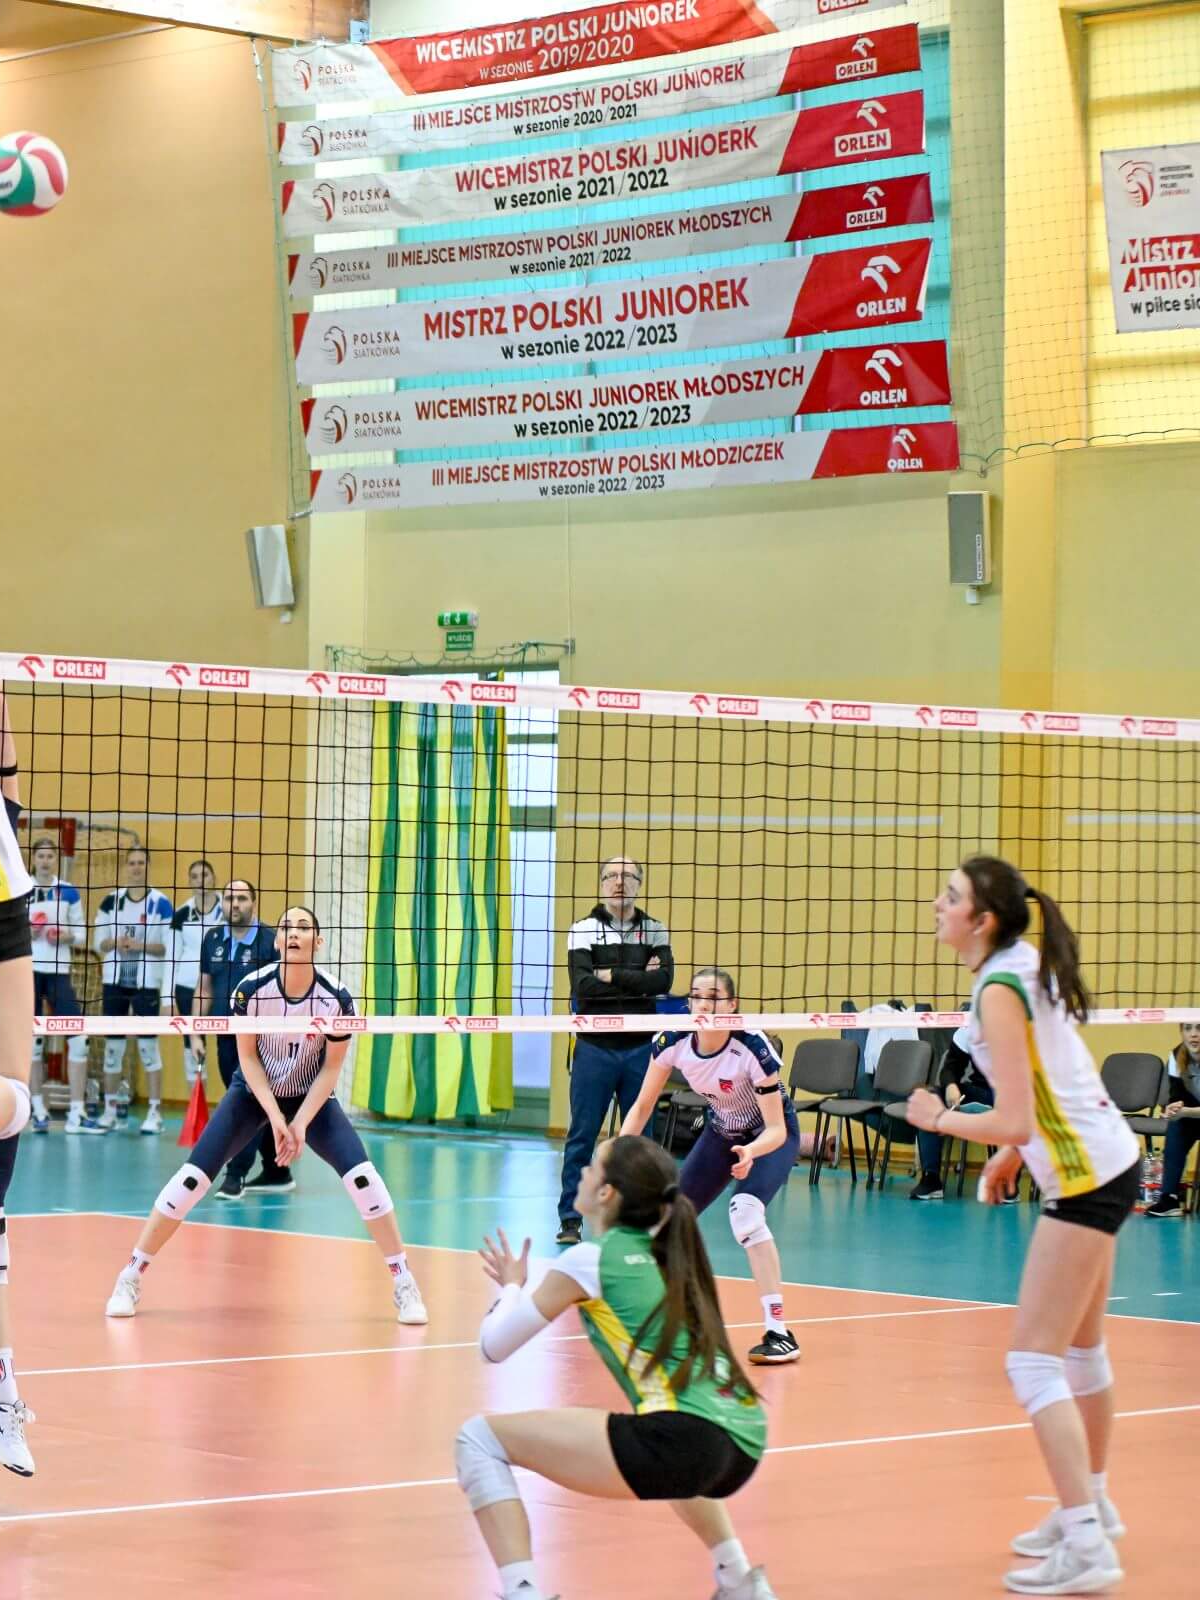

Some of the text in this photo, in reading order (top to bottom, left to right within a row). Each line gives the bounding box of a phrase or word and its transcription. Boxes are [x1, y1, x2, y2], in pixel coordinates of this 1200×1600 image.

[415, 0, 700, 64] WICEMISTRZ POLSKI JUNIOREK
[491, 60, 533, 78] SEZONIE
[537, 34, 634, 70] 2019/2020
[318, 63, 355, 75] POLSKA
[838, 61, 874, 77] ORLEN
[413, 63, 745, 131] III MIEJSCE MISTRZOSTW POLSKI JUNIOREK
[514, 104, 638, 135] w sezonie 2020/2021
[328, 128, 368, 140] POLSKA
[838, 134, 887, 153] ORLEN
[455, 126, 757, 192] WICEMISTRZ POLSKI JUNIOERK
[342, 187, 391, 202] POLSKA
[494, 168, 669, 210] w sezonie 2021/2022
[848, 211, 884, 225] ORLEN
[387, 205, 772, 268] III MIEJSCE MISTRZOSTW POLSKI JUNIOREK MŁODSZYCH
[1120, 237, 1194, 264] Mistrz
[332, 261, 371, 272] POLSKA
[510, 247, 631, 275] w sezonie 2021/2022
[424, 277, 749, 341] MISTRZ POLSKI JUNIOREK
[856, 297, 906, 319] ORLEN
[1130, 302, 1142, 314] w
[1145, 296, 1181, 317] piłce
[352, 331, 400, 345] POLSKA
[501, 322, 678, 360] w sezonie 2022/2023
[415, 365, 804, 421] WICEMISTRZ POLSKI JUNIOREK MŁODSZYCH
[860, 388, 907, 405] ORLEN
[354, 411, 401, 425] POLSKA
[514, 404, 691, 438] w sezonie 2022/2023
[354, 425, 402, 439] SIATKÓWKA
[432, 442, 785, 486] III MIEJSCE MISTRZOSTW POLSKI MŁODZICZEK
[887, 457, 923, 471] ORLEN
[362, 478, 401, 489] POLSKA
[539, 475, 665, 497] w sezonie 2022/2023
[55, 661, 104, 677] ORLEN
[202, 671, 247, 686] ORLEN
[339, 678, 384, 694] ORLEN
[473, 686, 515, 701] ORLEN
[599, 693, 639, 707] ORLEN
[718, 701, 758, 714] ORLEN
[833, 706, 871, 719] ORLEN
[48, 1020, 82, 1031] ORLEN
[194, 1020, 227, 1030] ORLEN
[288, 1042, 300, 1058] 11
